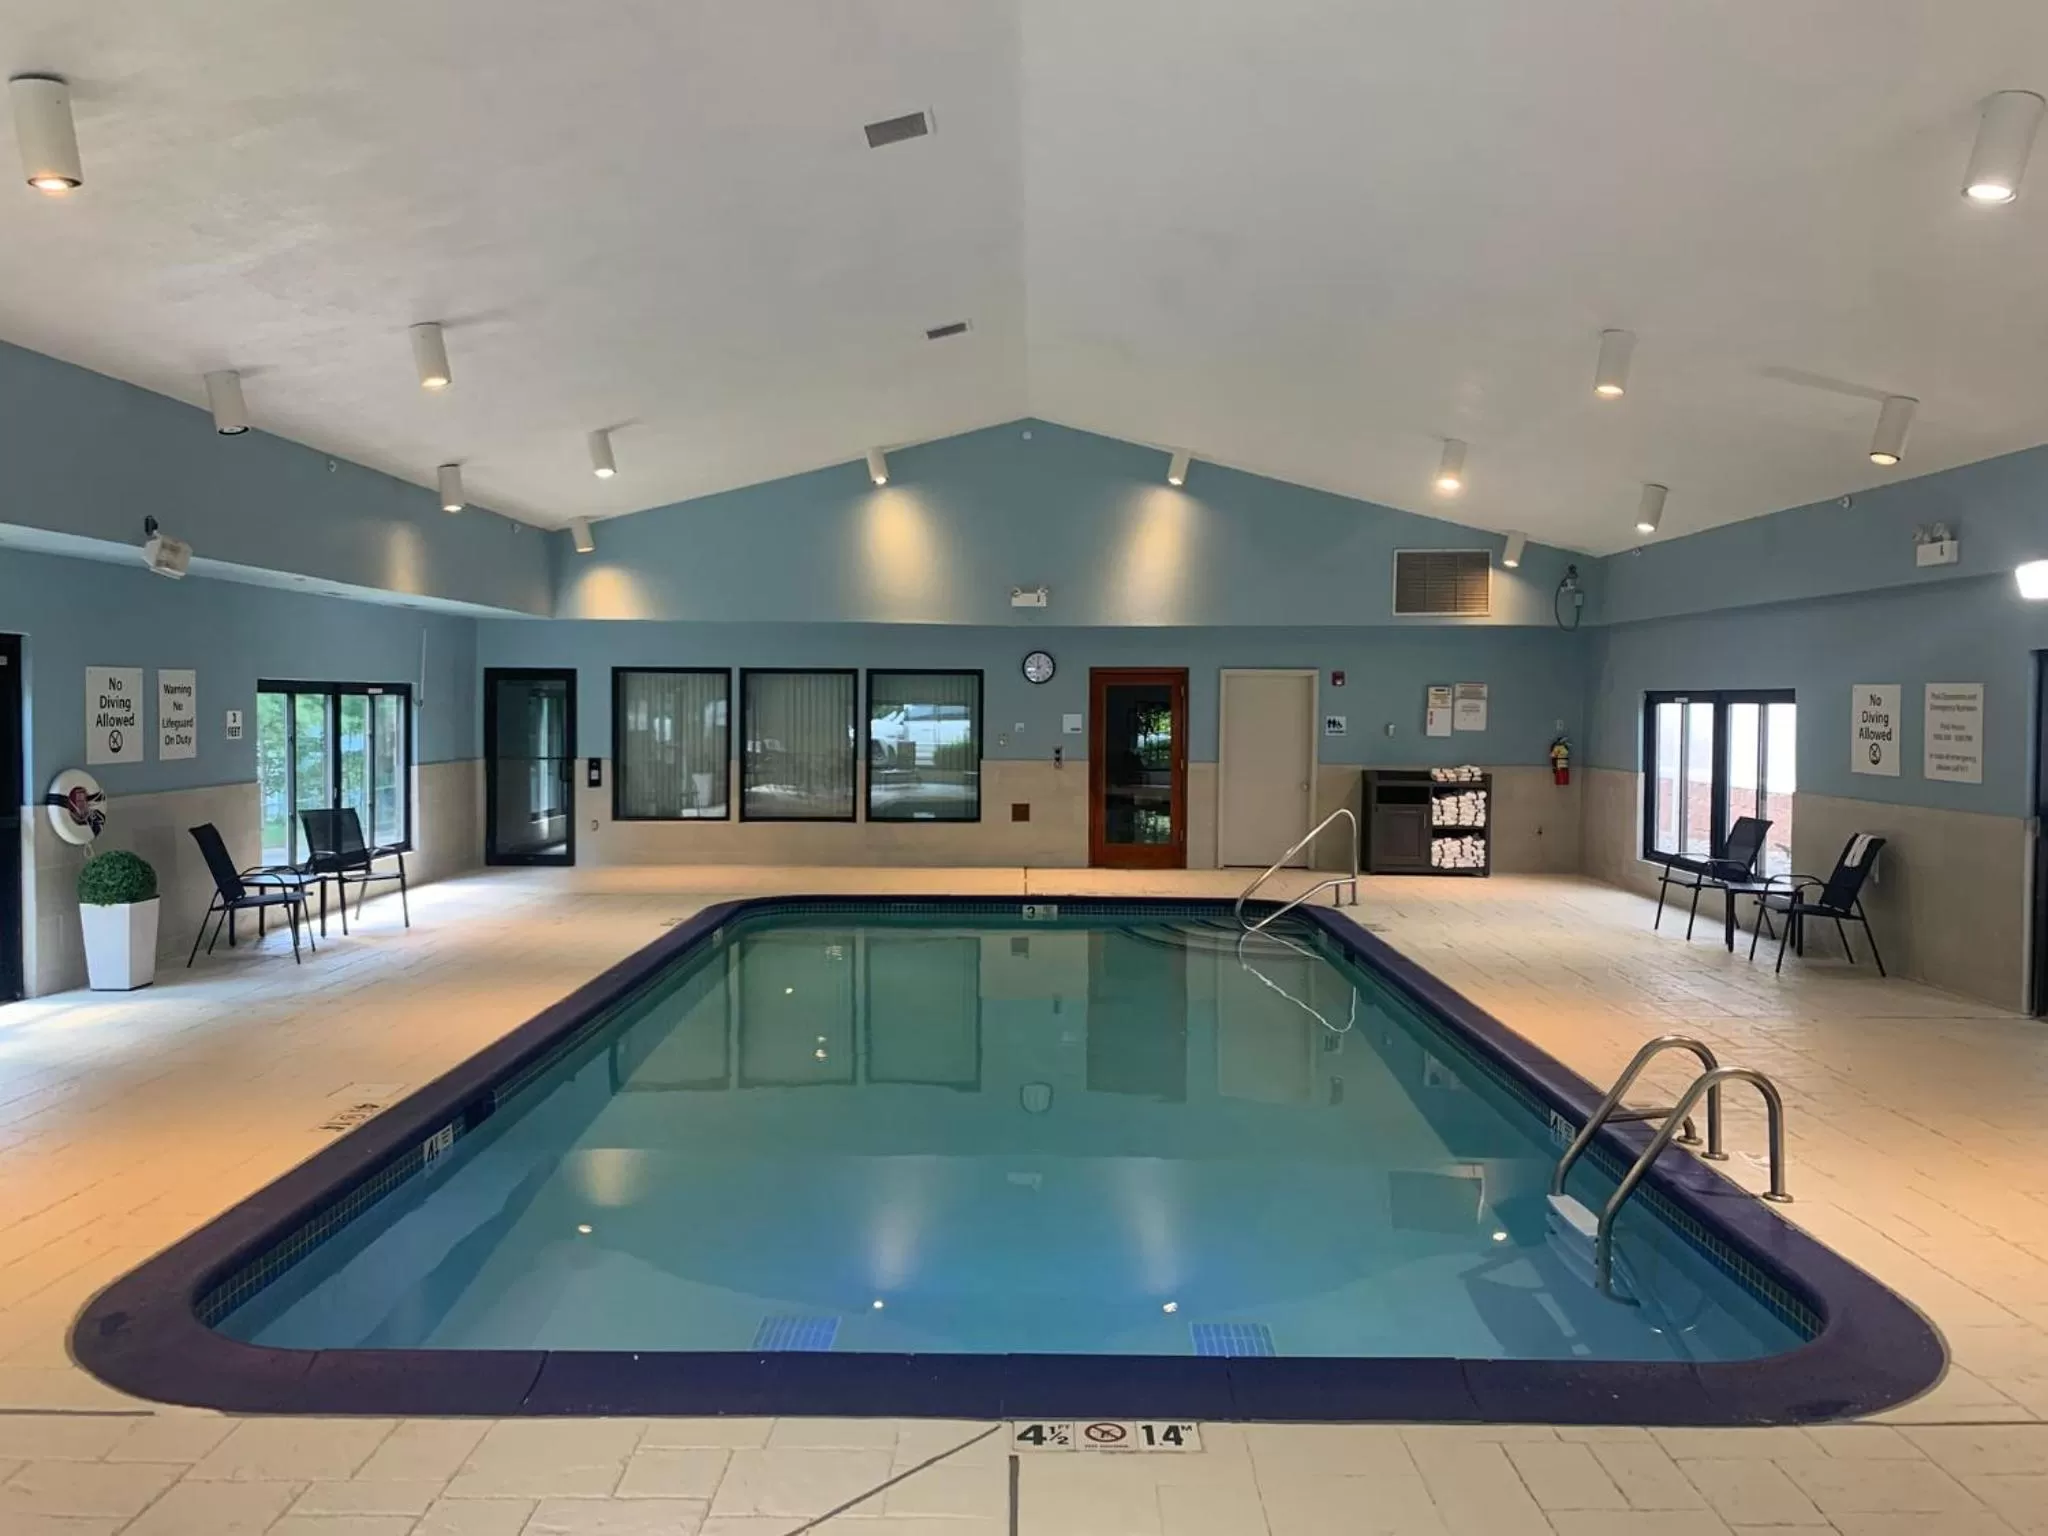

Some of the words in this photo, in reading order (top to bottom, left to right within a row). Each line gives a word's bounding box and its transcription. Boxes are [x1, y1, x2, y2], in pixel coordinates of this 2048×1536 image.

[108, 677, 123, 691] No
[163, 684, 192, 697] Warning
[99, 696, 131, 712] Diving
[172, 701, 183, 711] No
[1869, 694, 1882, 707] No
[95, 713, 135, 728] Allowed
[162, 717, 193, 731] Lifeguard
[1861, 711, 1889, 727] Diving
[164, 735, 175, 745] On
[176, 734, 192, 746] Duty
[1858, 728, 1892, 742] Allowed
